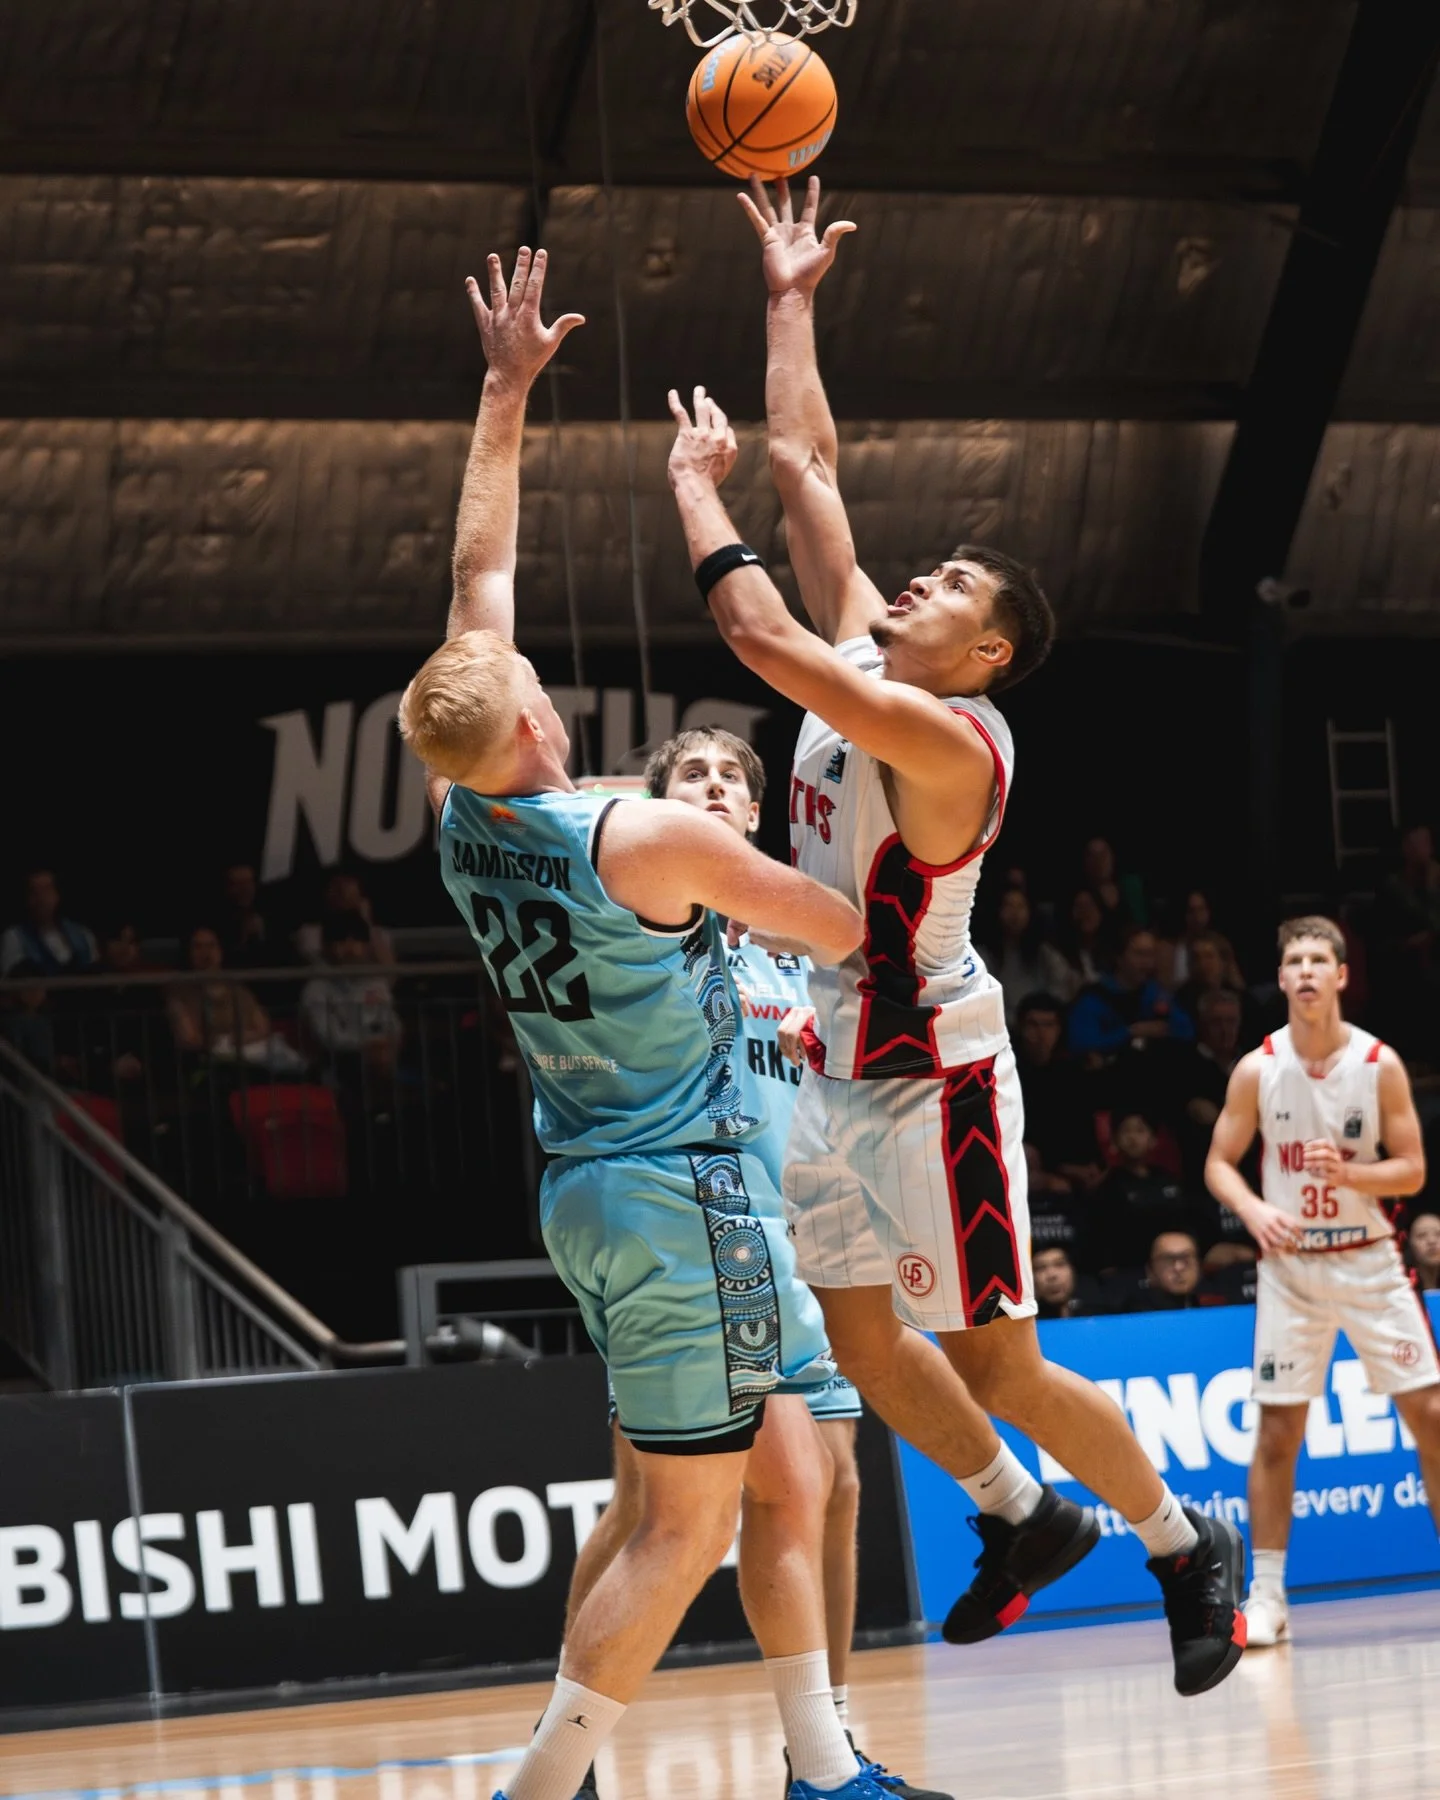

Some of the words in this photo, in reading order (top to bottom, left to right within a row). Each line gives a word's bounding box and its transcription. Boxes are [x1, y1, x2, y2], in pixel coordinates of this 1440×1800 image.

[258, 685, 770, 885] NOTH
[469, 891, 594, 1021] 22
[1301, 1184, 1339, 1219] 35
[1292, 1483, 1385, 1519] every
[1394, 1471, 1430, 1509] da
[0, 1503, 323, 1629] BISHI
